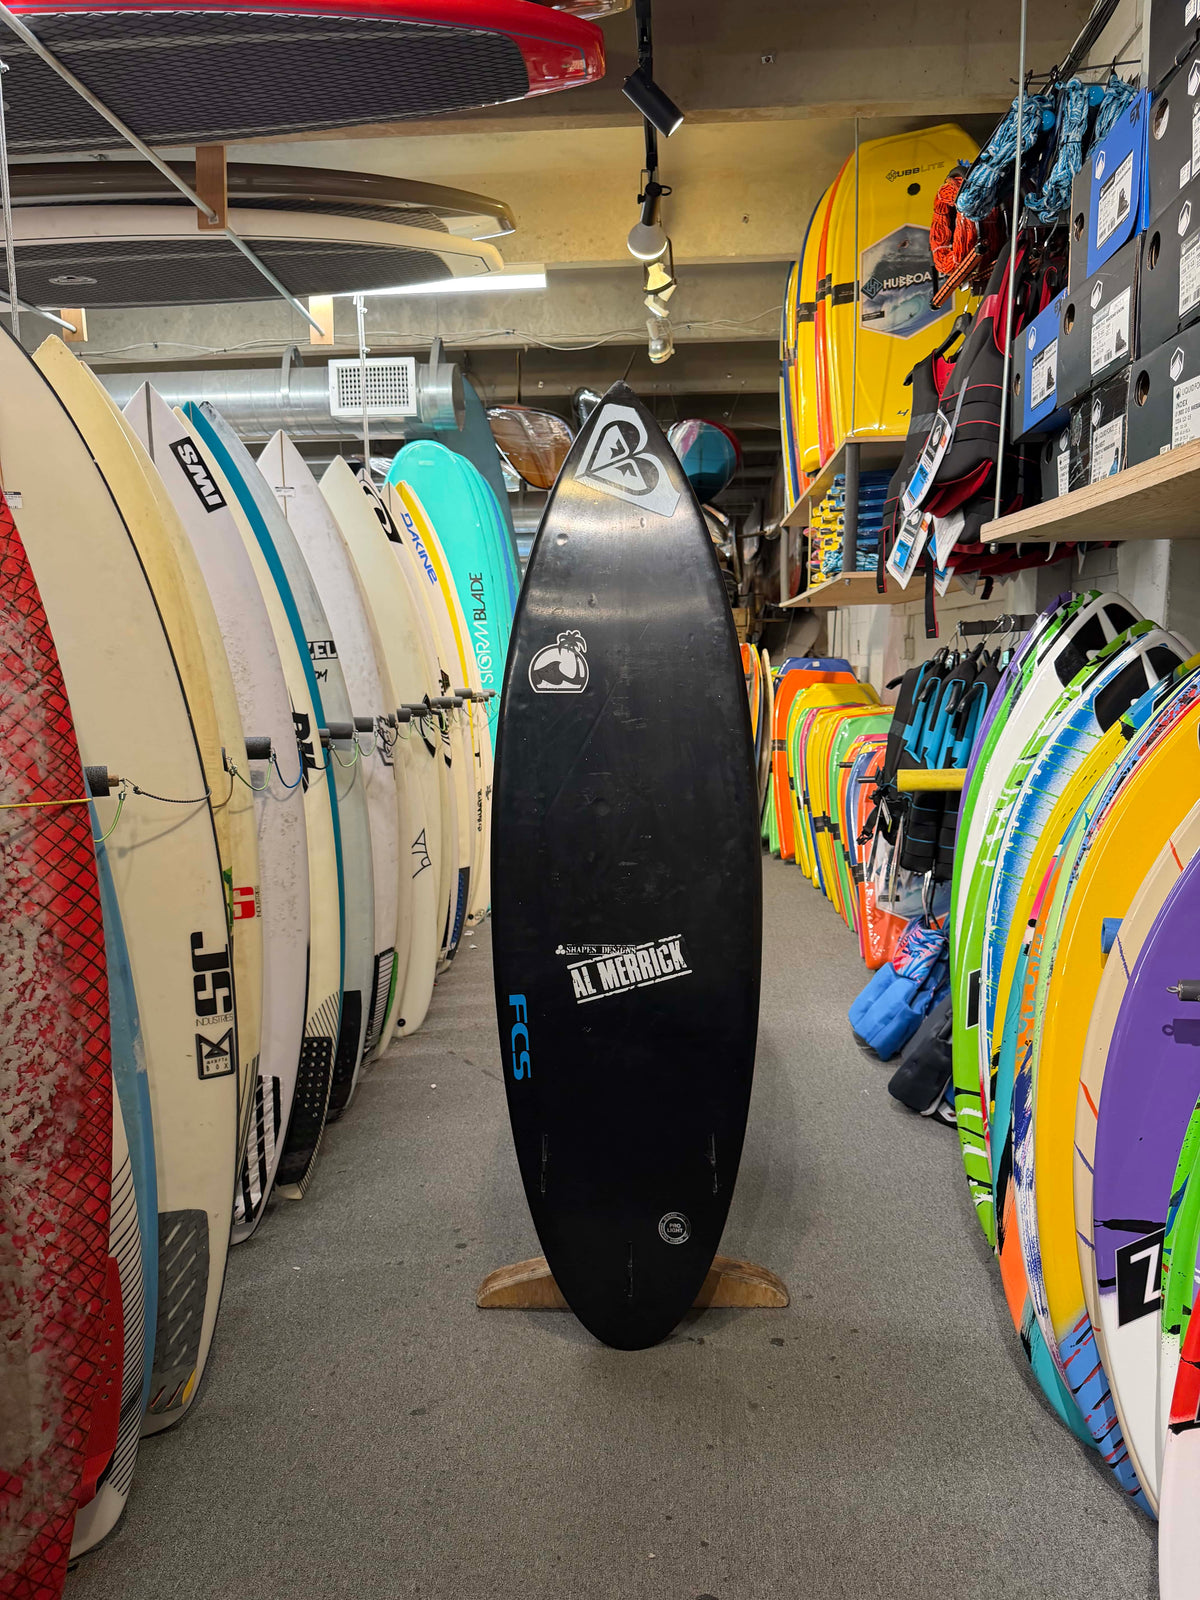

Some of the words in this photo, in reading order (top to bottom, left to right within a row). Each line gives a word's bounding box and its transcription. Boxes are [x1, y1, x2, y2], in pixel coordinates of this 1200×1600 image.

[400, 512, 437, 585] DAKINE
[566, 945, 597, 954] SHAPES
[602, 945, 637, 954] DESIGNS
[570, 966, 597, 999] AL
[596, 940, 688, 991] MERRICK
[195, 1013, 234, 1027] INDUSTRIES
[508, 993, 532, 1081] FCS
